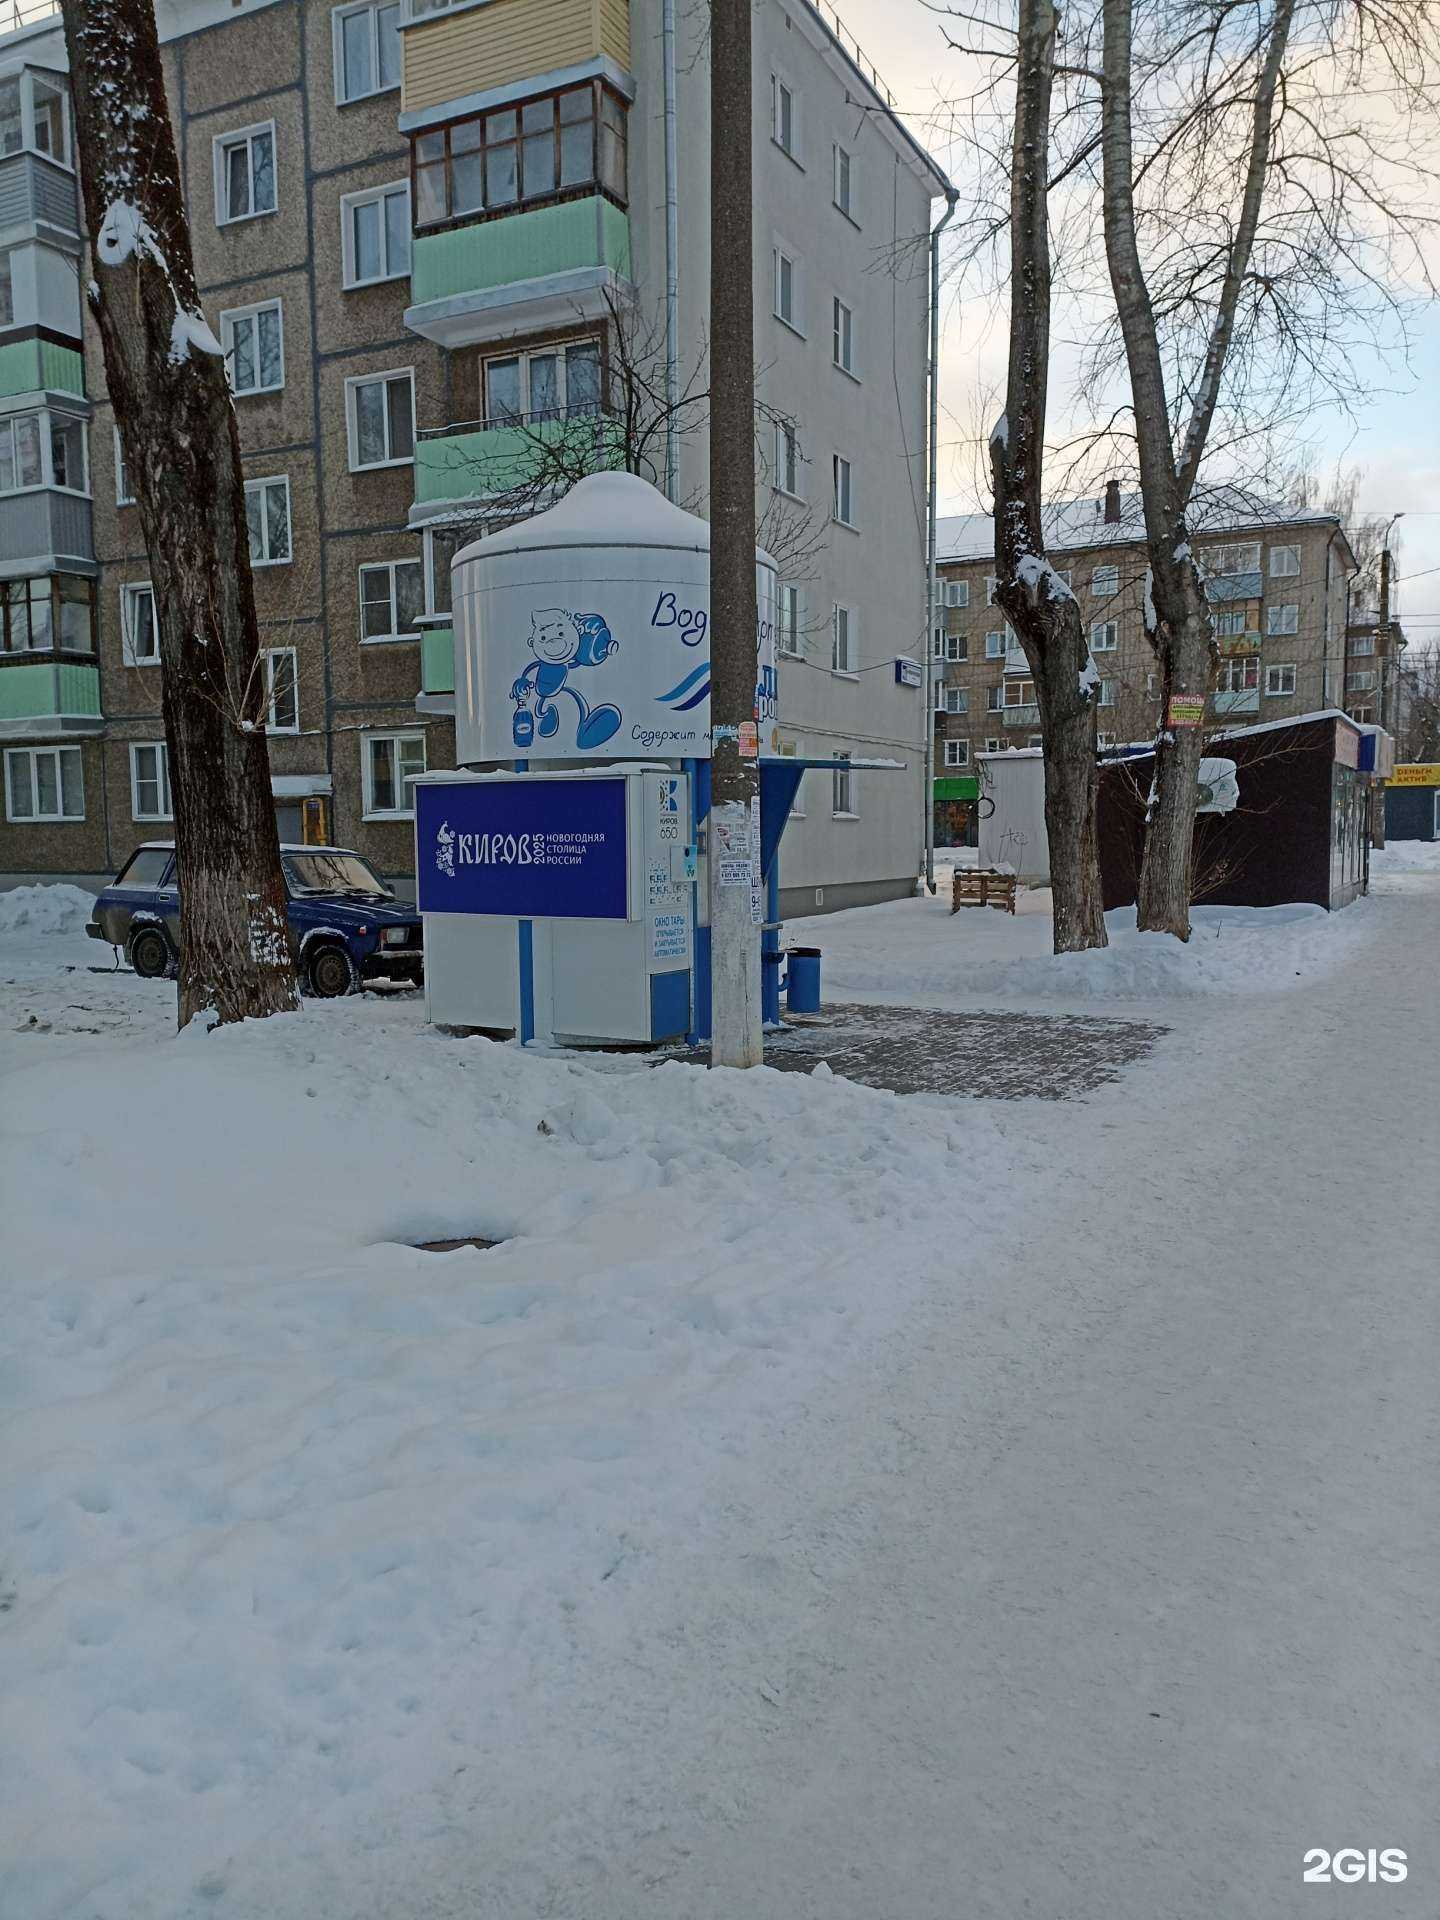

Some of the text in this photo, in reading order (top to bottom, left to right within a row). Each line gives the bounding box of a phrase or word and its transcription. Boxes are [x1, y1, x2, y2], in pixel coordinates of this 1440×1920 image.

[631, 724, 696, 747] Содержит
[659, 817, 678, 825] КИРОВ
[546, 833, 605, 843] НОВОГОДНЯЯ
[660, 826, 678, 839] 650
[458, 833, 533, 865] КИРОВ
[533, 833, 545, 865] 2025
[546, 845, 587, 855] СТОЛИЦА
[546, 856, 582, 865] РОССИИ
[655, 915, 685, 927] ОКНО ТАРЫ
